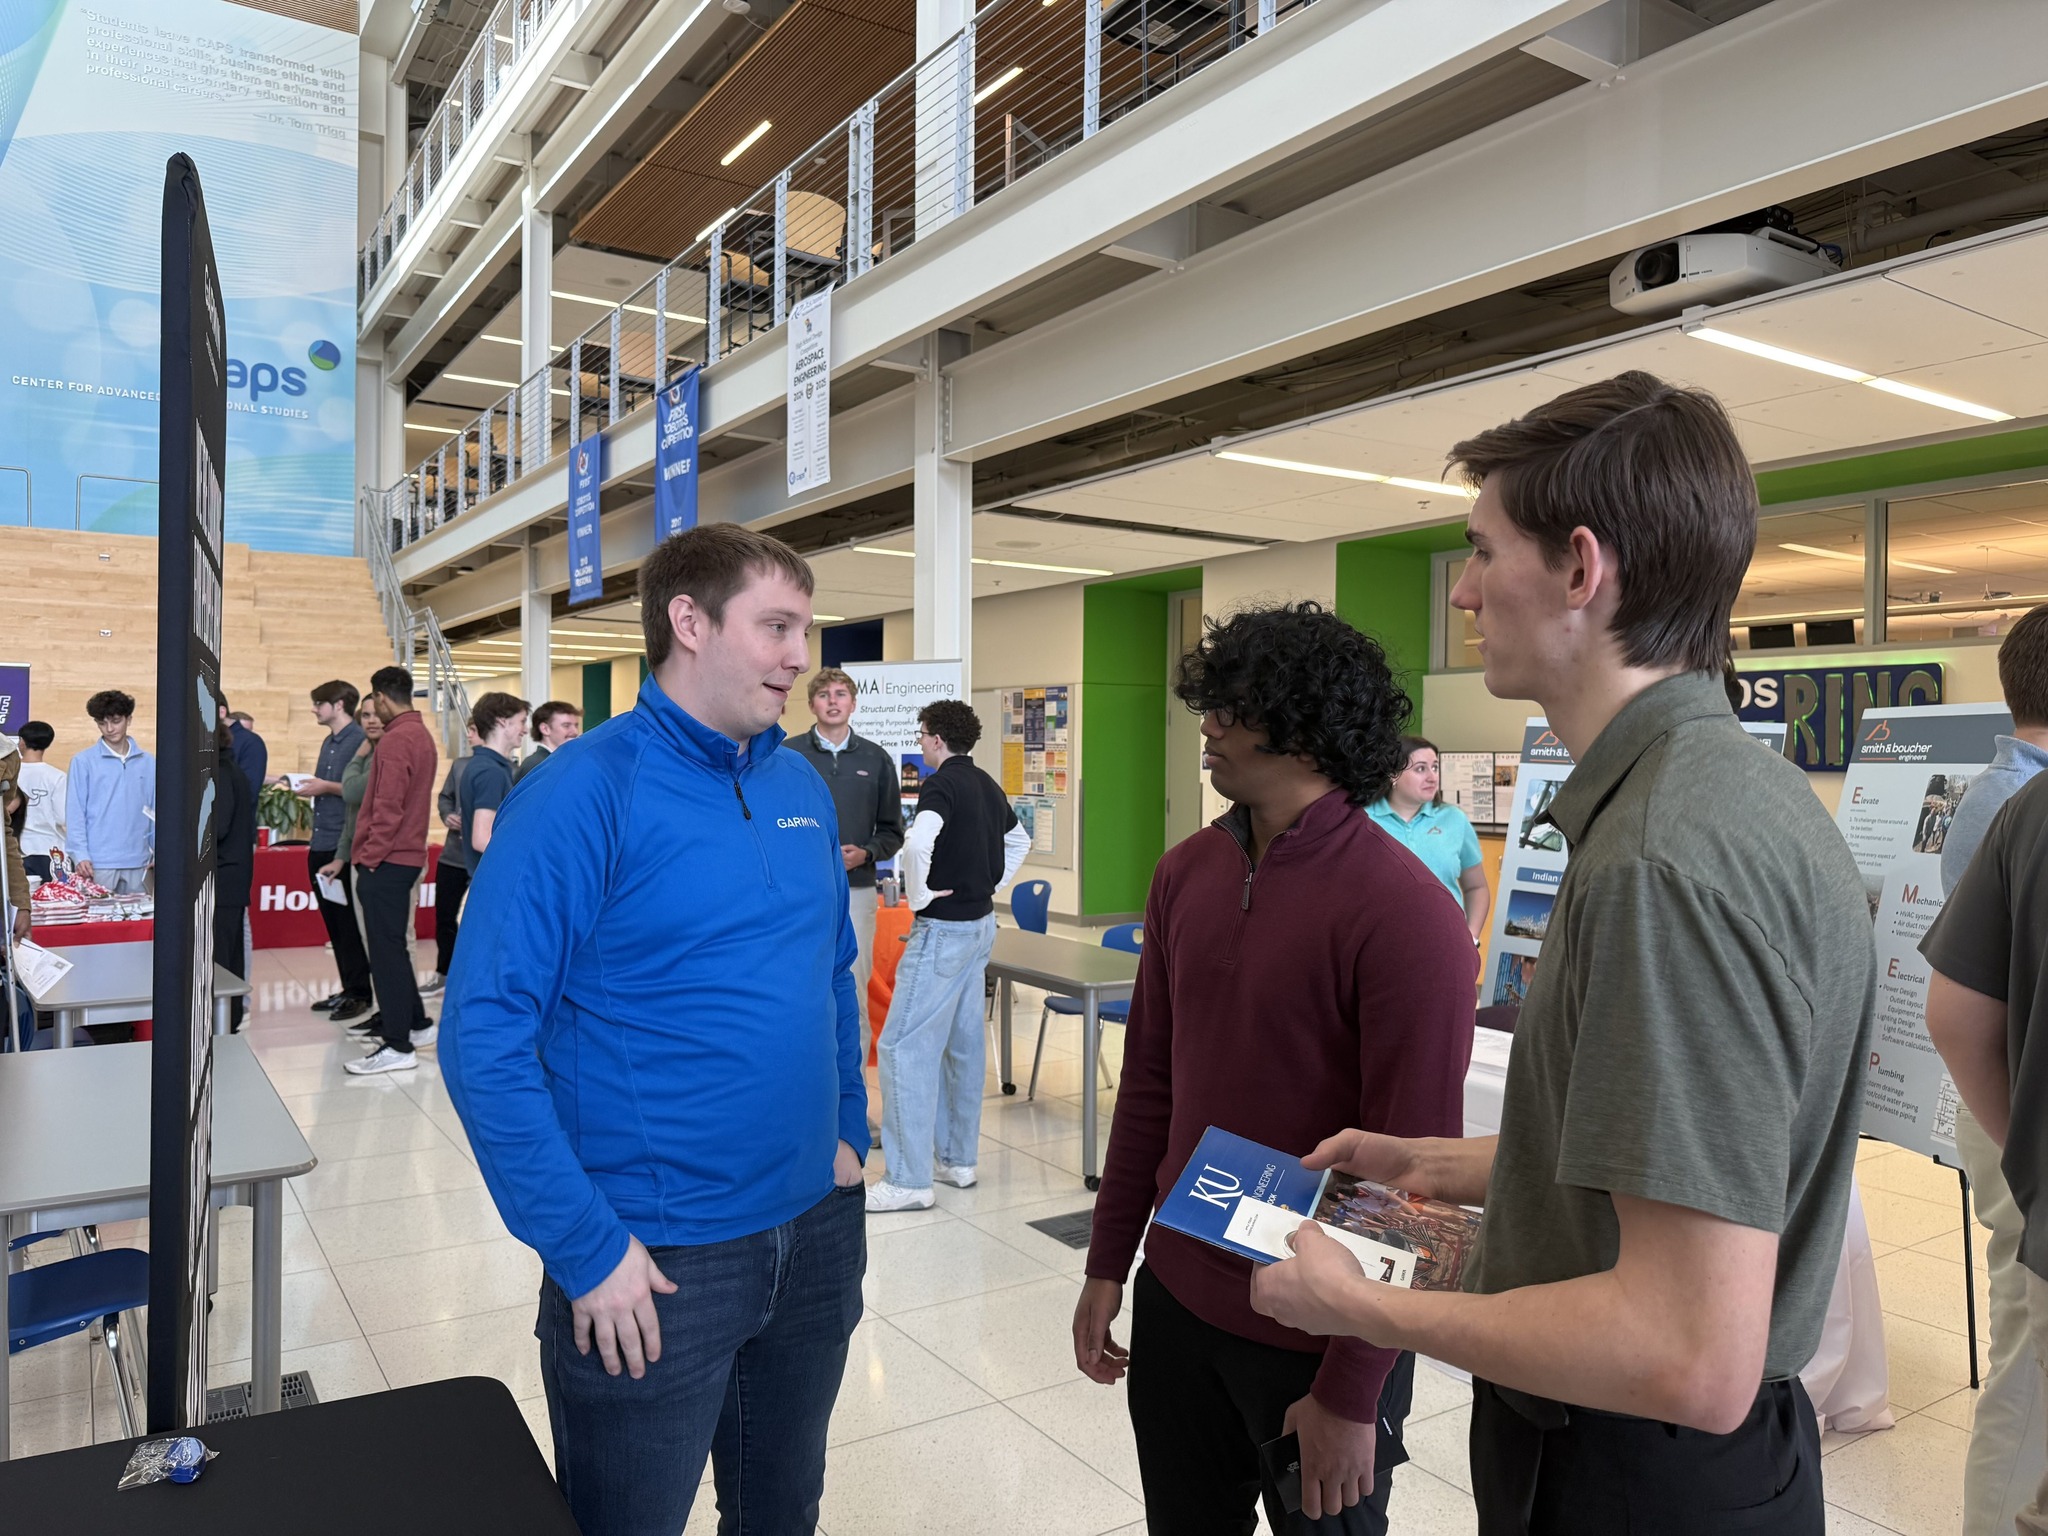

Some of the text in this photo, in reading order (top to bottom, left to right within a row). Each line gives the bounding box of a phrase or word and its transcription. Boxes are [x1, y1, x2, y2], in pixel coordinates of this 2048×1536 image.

[87, 26, 172, 52] professional
[220, 55, 277, 76] business
[281, 71, 318, 86] ethics
[323, 80, 345, 92] and
[155, 27, 190, 43] leave
[196, 37, 234, 54] CAPS
[240, 47, 314, 73] transformed
[320, 67, 345, 80] with
[87, 38, 345, 105] experiences that give them an advantage
[87, 63, 170, 89] professional
[87, 50, 345, 117] in their post-secondary education and
[288, 117, 313, 131] Tom
[315, 123, 346, 140] Trigg
[795, 348, 824, 372] AEROSPACE
[227, 358, 307, 402] aps
[794, 361, 827, 387] ENGINEERING
[815, 378, 826, 391] 2025
[12, 375, 63, 390] CENTER
[68, 382, 93, 393] FOR
[260, 405, 309, 419] STUDIES
[668, 402, 687, 422] FIRST
[856, 678, 954, 697] MA Engineering
[861, 704, 896, 714] Structural
[851, 719, 885, 728] Engineering
[885, 718, 915, 727] Purposeful
[855, 729, 874, 738] mplex
[876, 729, 902, 737] Structural
[1530, 747, 1570, 758] smith&b
[1899, 754, 1927, 762] engineers
[1852, 786, 1879, 805] Elevate
[777, 816, 820, 829] GARMIN
[1532, 871, 1558, 883] Indian
[1902, 883, 1943, 907] Mechanic
[1900, 910, 1915, 918] HVAC
[1896, 929, 1923, 940] Ventilation
[1906, 921, 1918, 929] duct
[1887, 957, 1925, 985] Electrical
[1883, 984, 1917, 998] Power Design
[1888, 1005, 1915, 1017] Equipment
[1889, 995, 1923, 1009] Outlet layout
[1877, 1013, 1915, 1028] Lighting Design
[1884, 1024, 1932, 1042] Light fixture select
[1882, 1034, 1937, 1054] Software calculations
[1869, 1052, 1905, 1083] Plumbing
[1868, 1080, 1904, 1097] torm drainage
[1866, 1089, 1918, 1113] ot/cold water piping
[1866, 1100, 1916, 1123] anitary/waste piping
[1188, 1163, 1244, 1211] KU
[1252, 1163, 1277, 1201] NGINEERING
[1267, 1193, 1278, 1206] OOK
